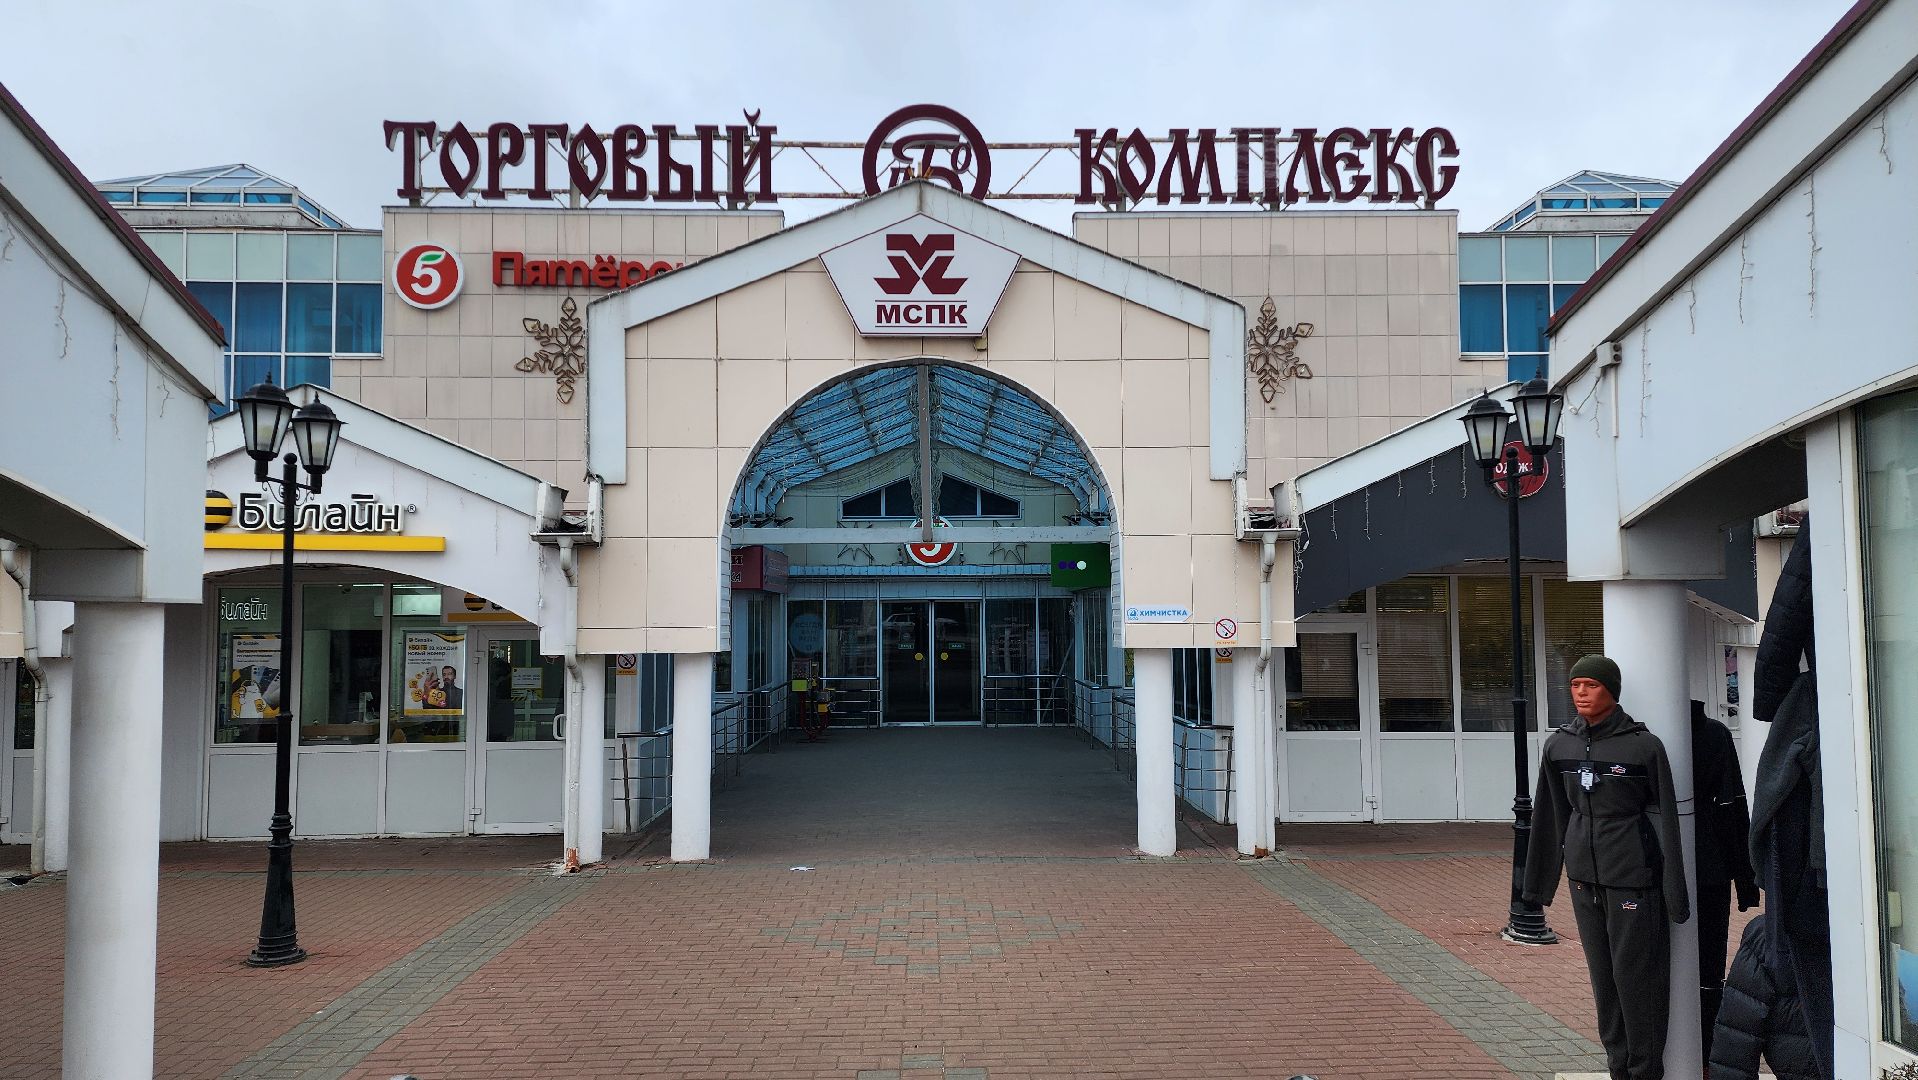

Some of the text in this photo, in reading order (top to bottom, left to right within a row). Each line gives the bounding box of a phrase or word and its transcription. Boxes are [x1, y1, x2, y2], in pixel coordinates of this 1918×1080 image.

[383, 108, 1460, 205] ТОРГОВЫЙ КОМПЛЕКС
[492, 251, 684, 289] Пятёро
[875, 304, 968, 325] МСПК
[1139, 609, 1188, 617] ХИМЧИСТКА
